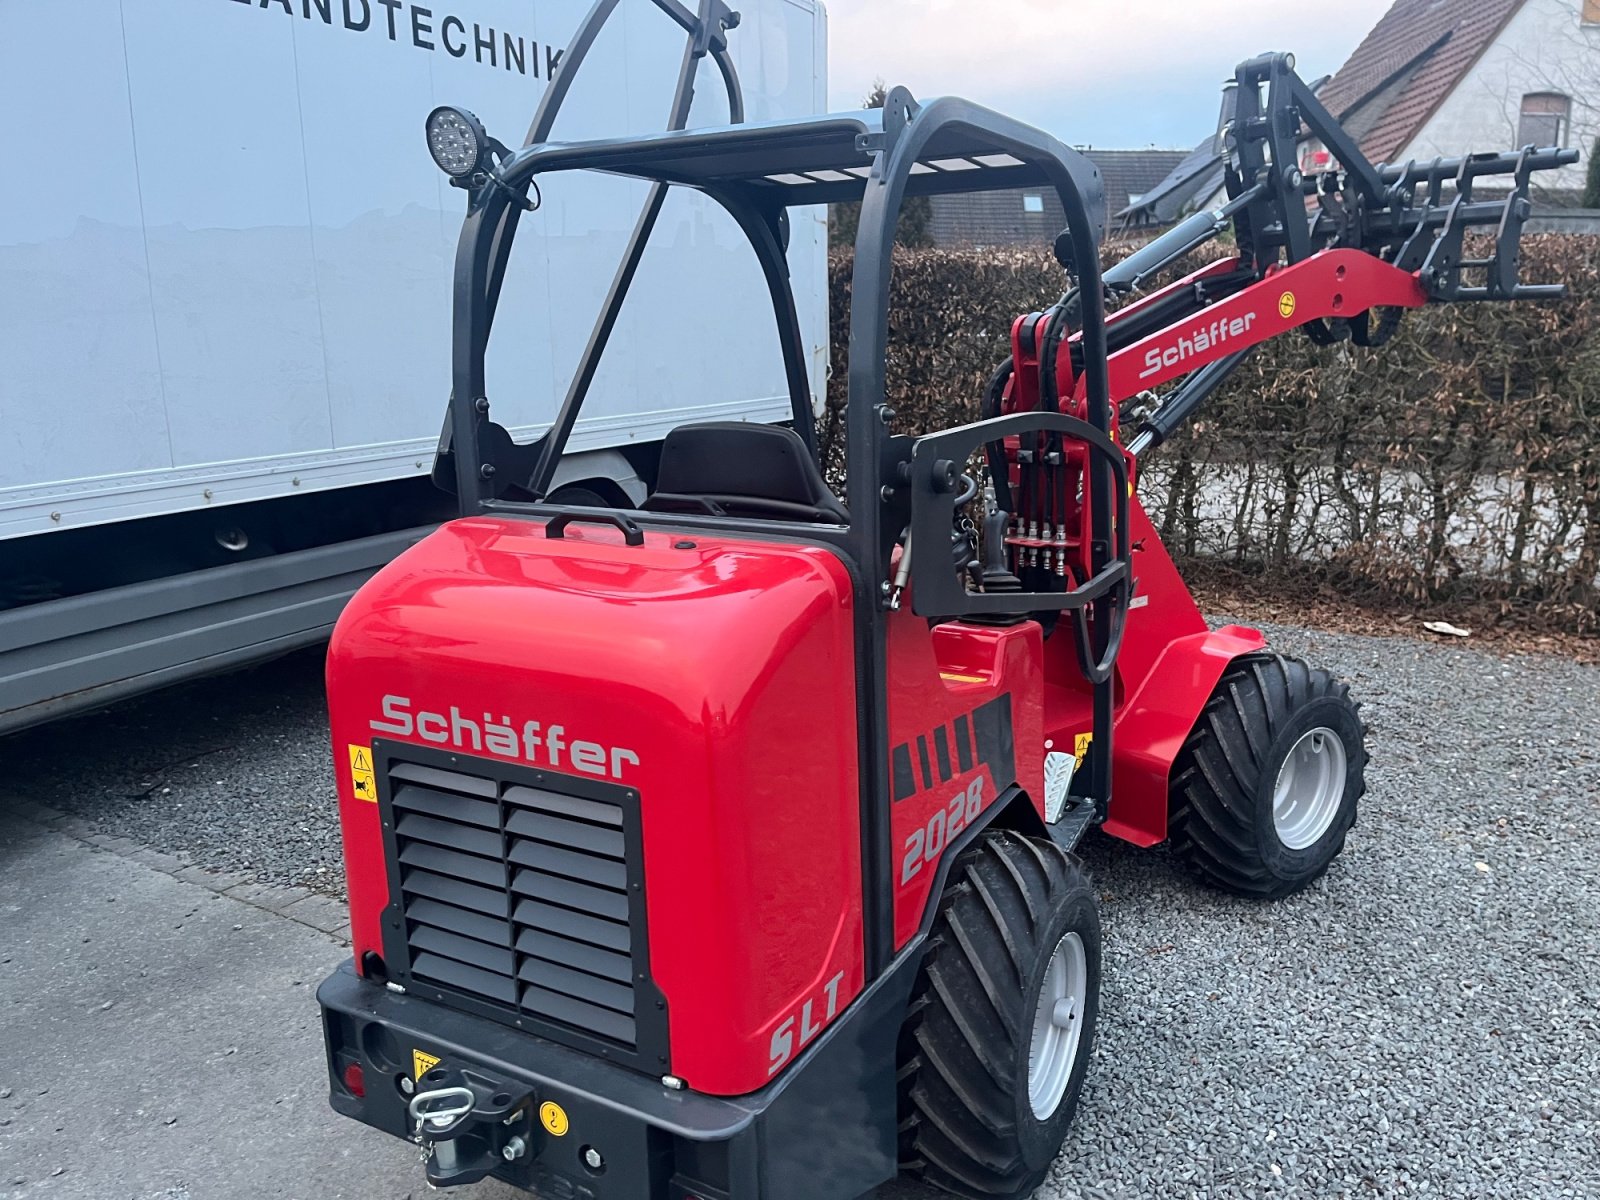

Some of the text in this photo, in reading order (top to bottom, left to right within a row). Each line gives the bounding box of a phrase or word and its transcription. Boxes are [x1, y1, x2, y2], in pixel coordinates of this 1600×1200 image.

[229, 0, 565, 82] DTECHNIK
[1139, 312, 1256, 379] Schäffer
[369, 694, 640, 779] Schäffer
[901, 775, 984, 886] 2028
[767, 970, 844, 1076] SLT
